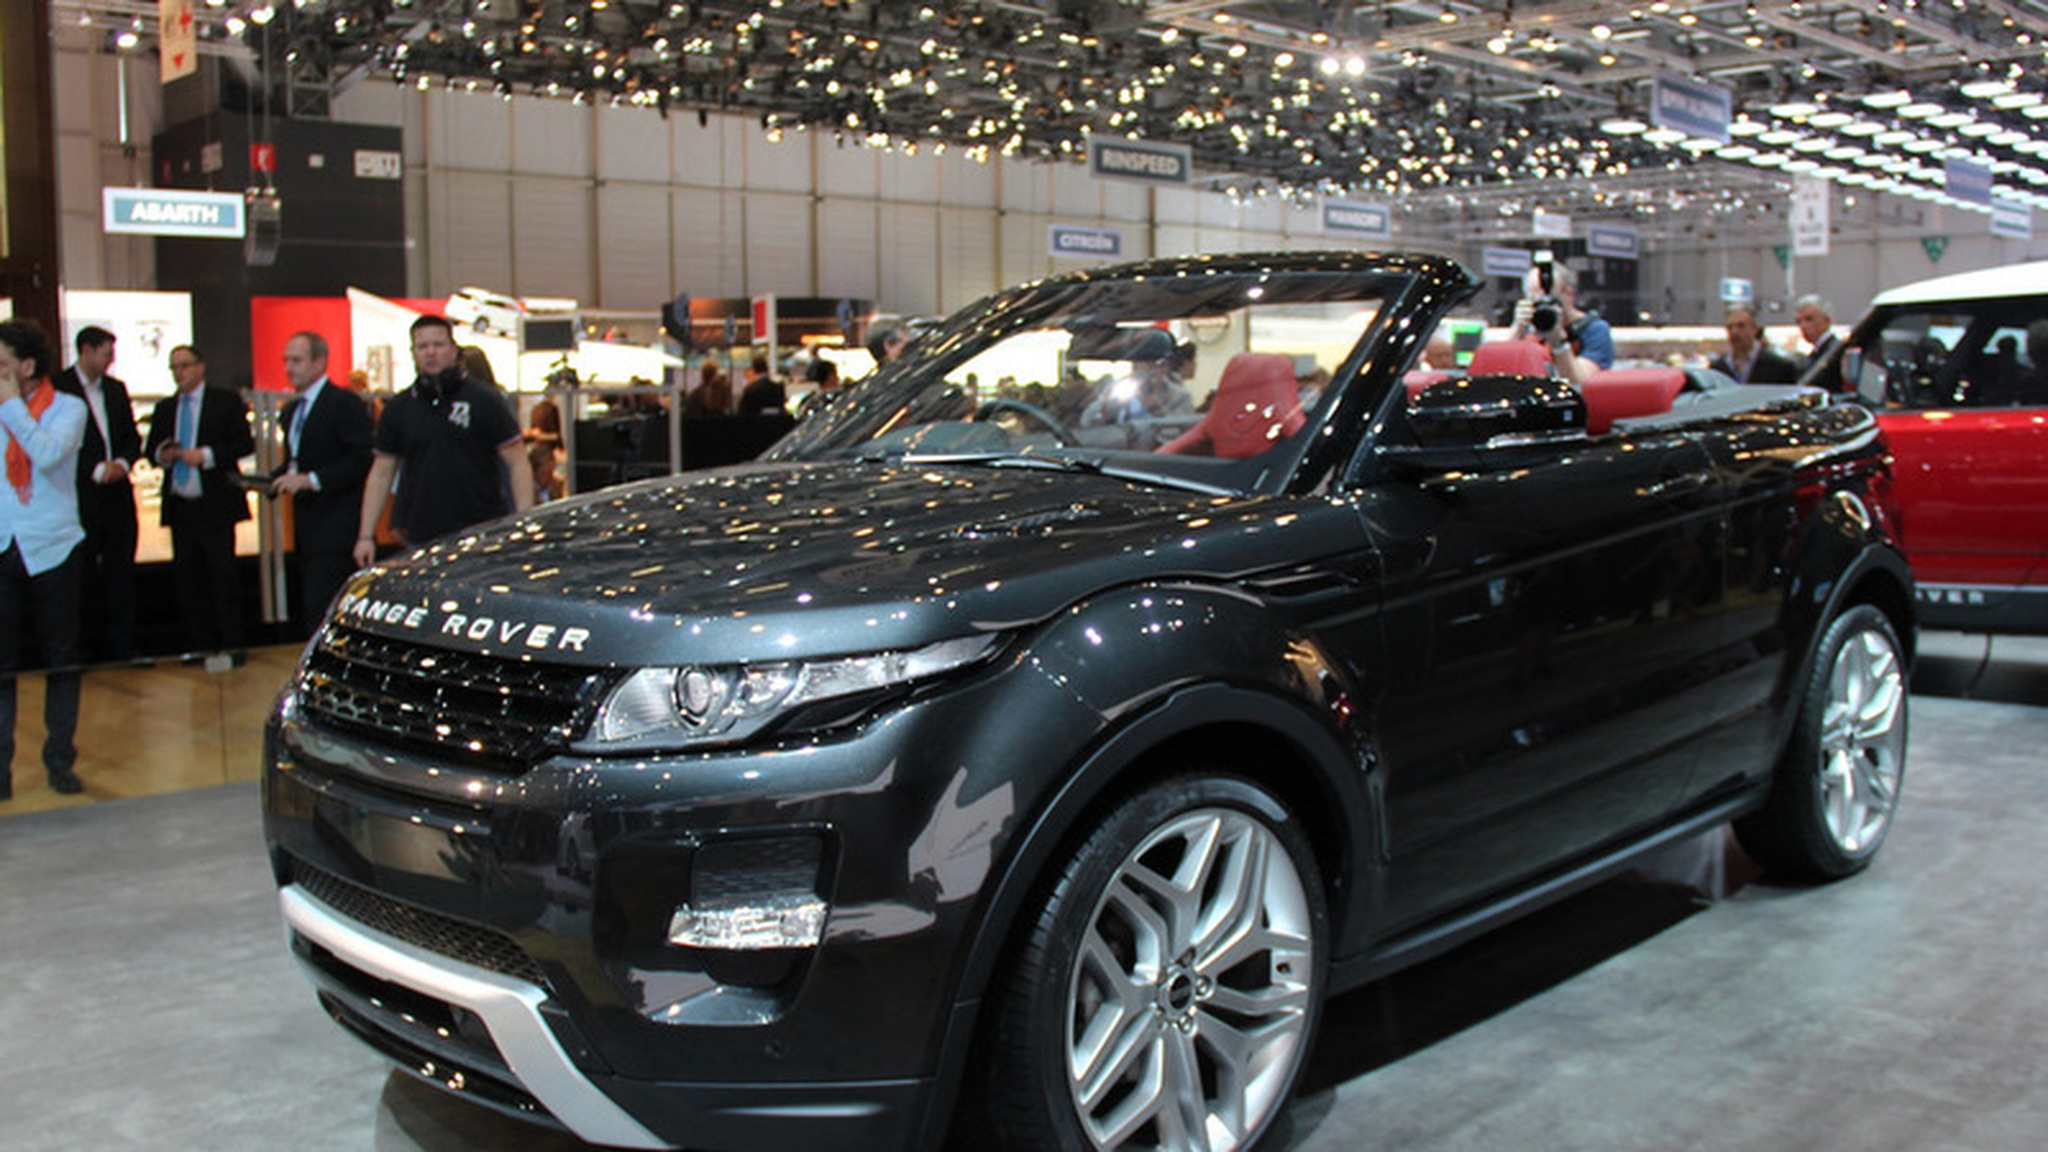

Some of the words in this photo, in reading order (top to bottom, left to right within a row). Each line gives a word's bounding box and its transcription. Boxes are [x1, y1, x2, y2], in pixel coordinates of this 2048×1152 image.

[1102, 148, 1179, 176] RINSPEED
[130, 200, 219, 224] ABARTH
[1915, 588, 1983, 604] VER
[338, 593, 428, 629] RANGE
[442, 613, 590, 652] ROVER
